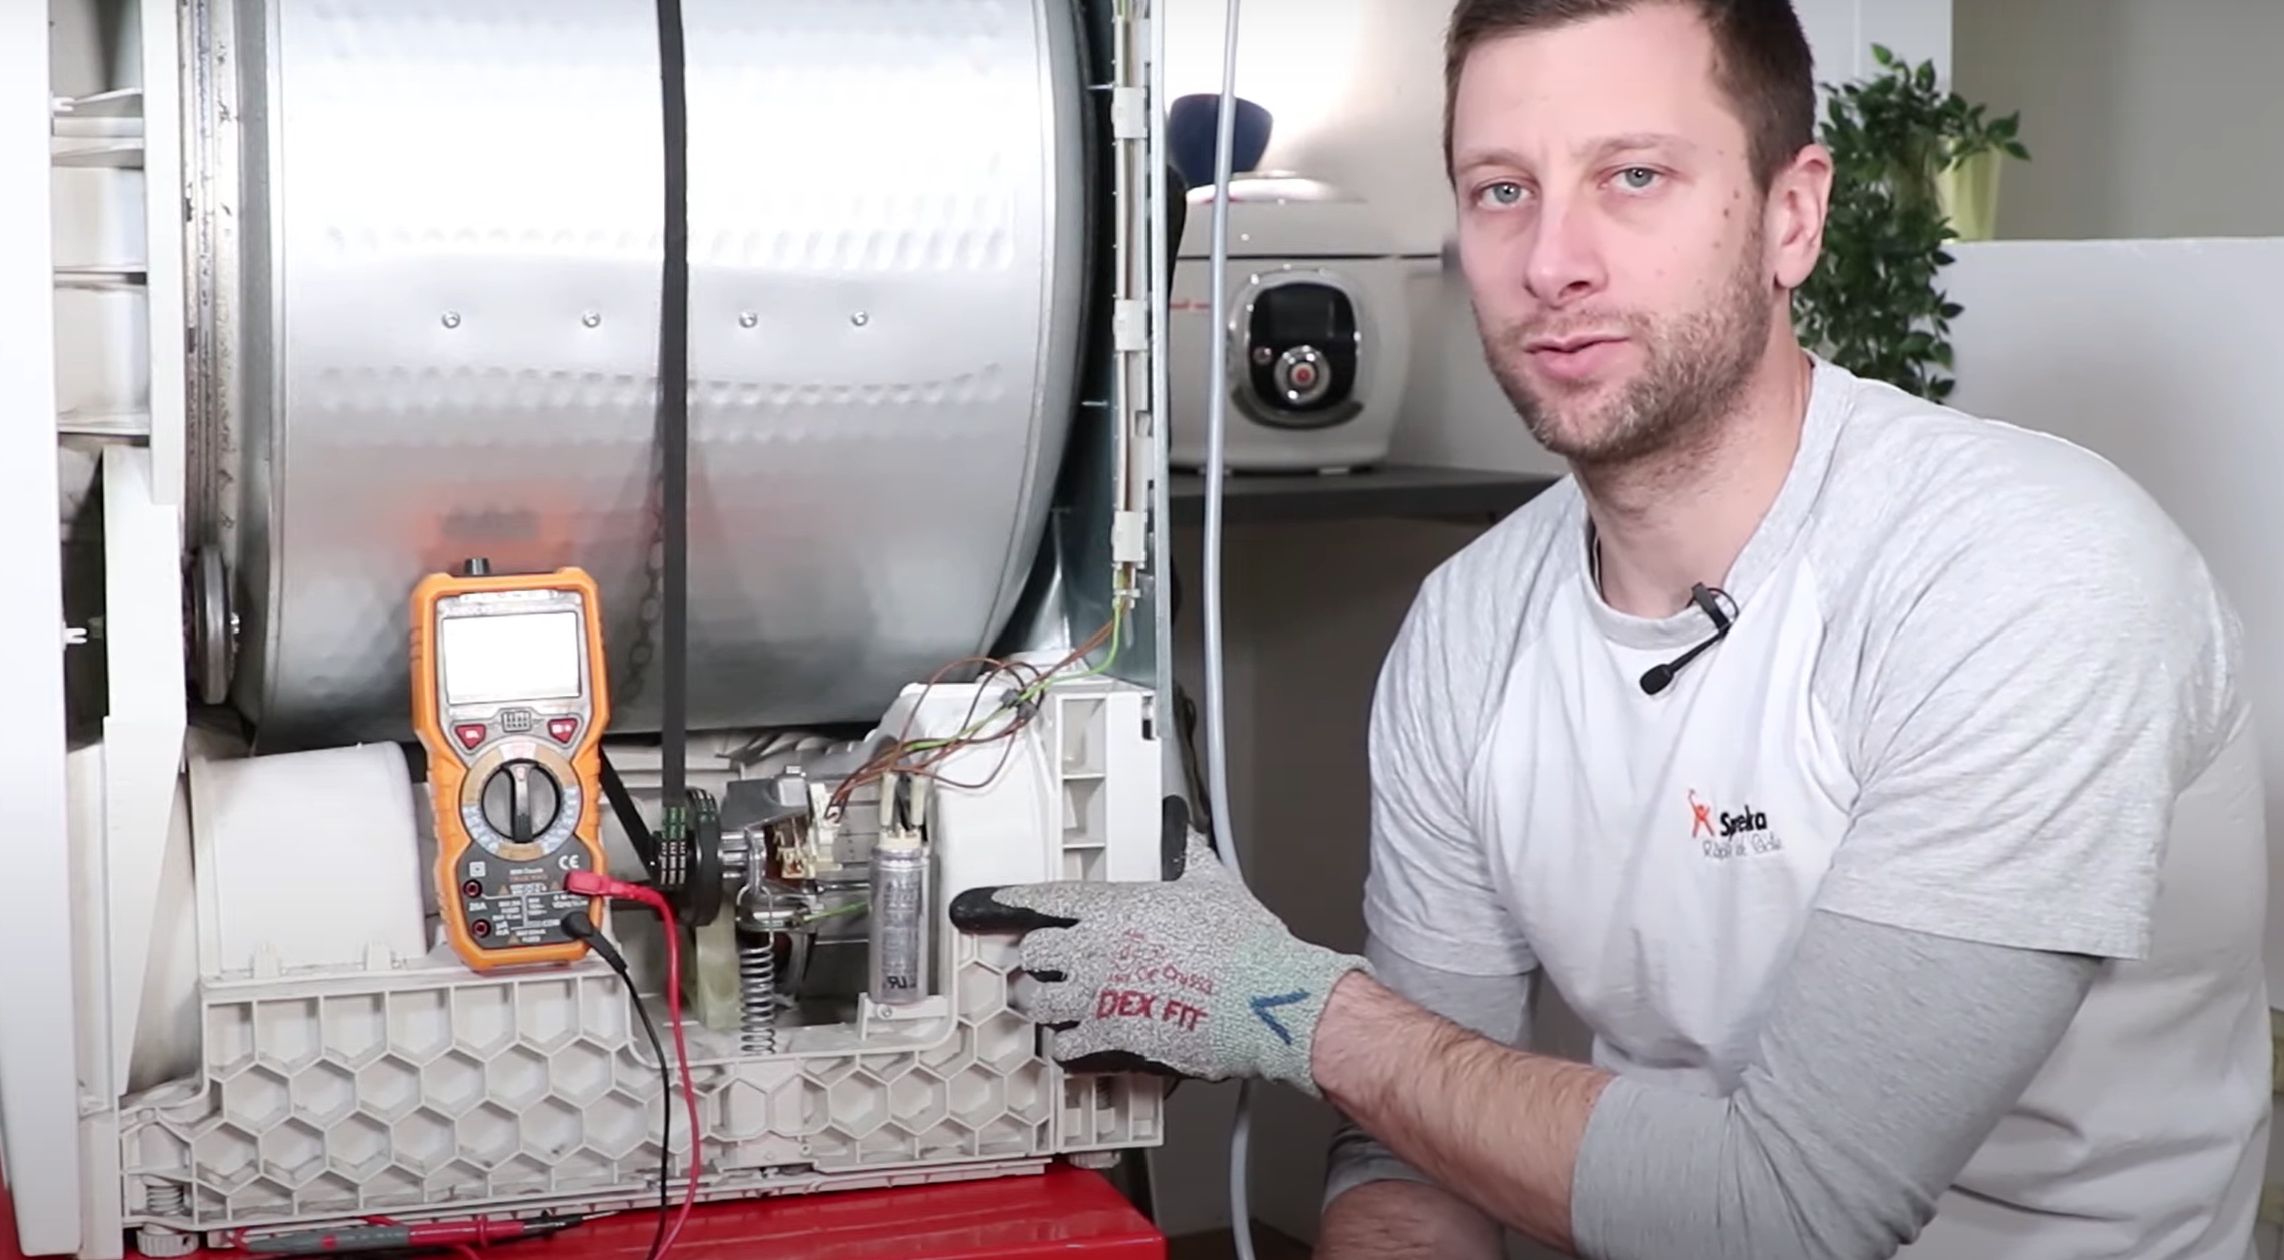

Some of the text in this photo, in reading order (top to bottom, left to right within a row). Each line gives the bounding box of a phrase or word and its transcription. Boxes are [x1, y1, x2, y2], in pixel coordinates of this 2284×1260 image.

[558, 855, 579, 870] CE
[1096, 990, 1208, 1031] DEX FIT
